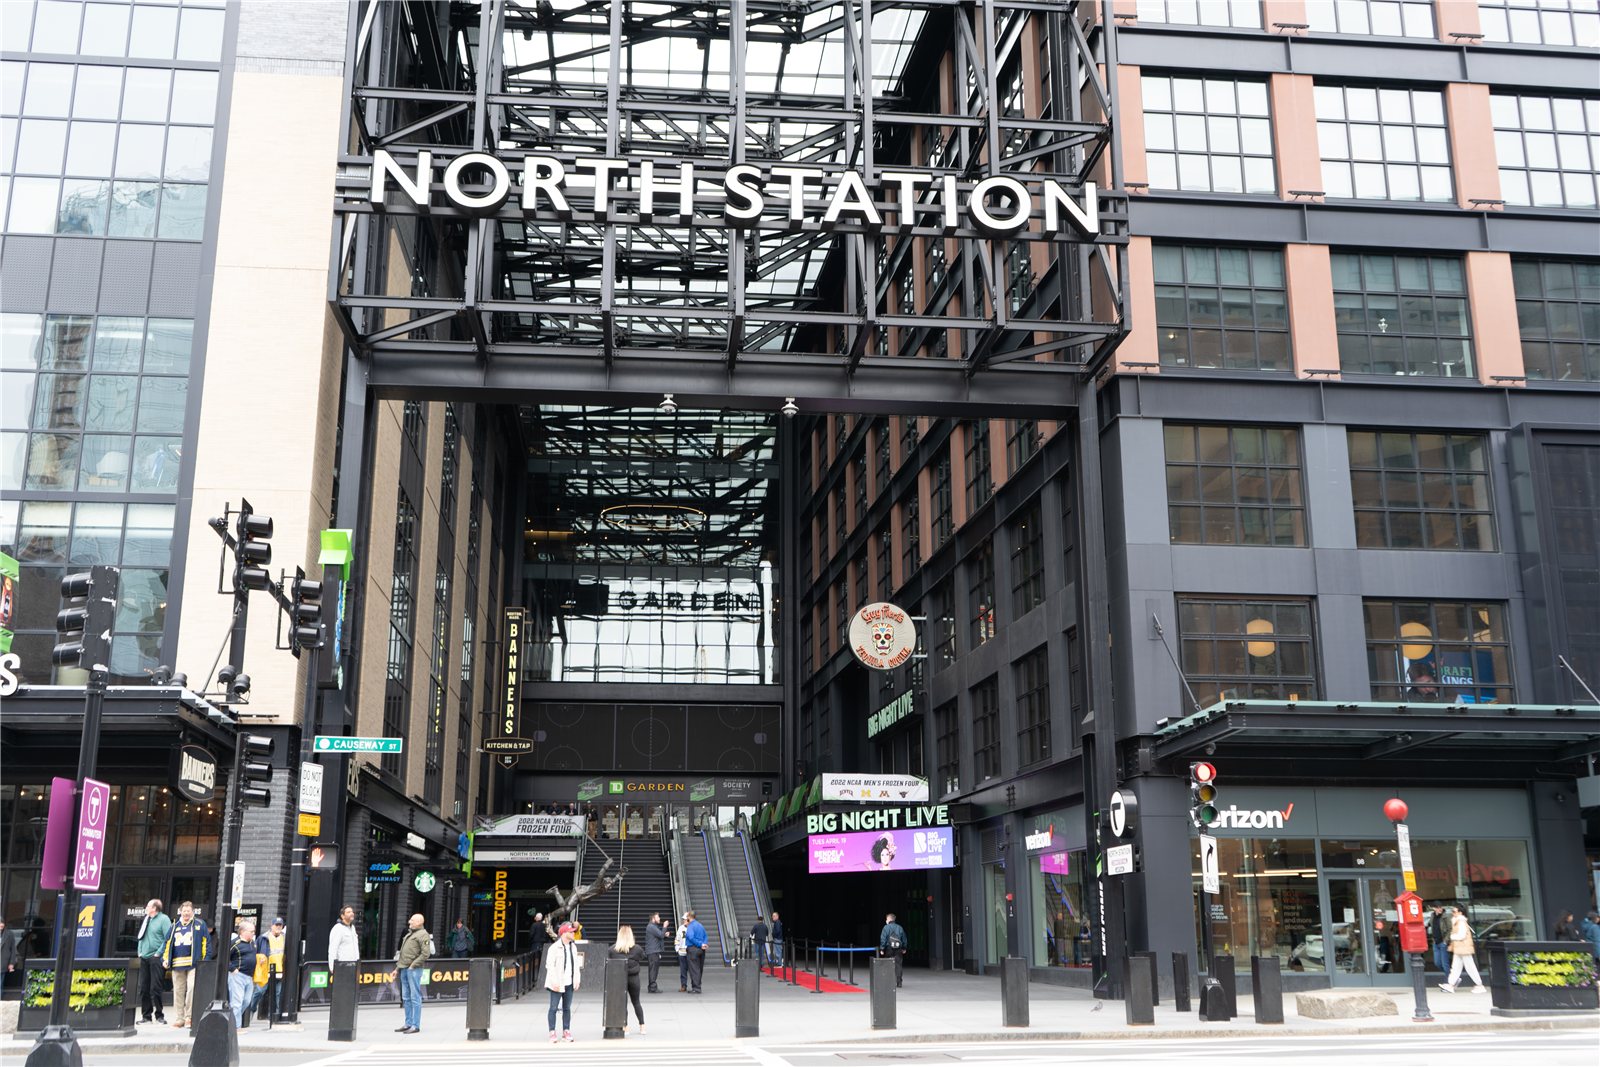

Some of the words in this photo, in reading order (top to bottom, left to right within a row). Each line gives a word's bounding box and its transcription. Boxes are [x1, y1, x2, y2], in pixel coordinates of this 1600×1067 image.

[371, 150, 694, 214] NORTH
[724, 163, 1101, 235] STATION
[505, 623, 518, 734] BANNERS
[1441, 666, 1472, 677] RAFT
[867, 713, 879, 739] BIG
[878, 700, 897, 732] NIGHT
[897, 689, 914, 720] LIVE
[334, 740, 384, 750] CAUSEWAY
[181, 751, 215, 789] BANNERS
[612, 783, 623, 791] TD
[627, 783, 684, 791] GARDEN
[807, 814, 838, 833] BIG
[841, 808, 901, 831] NIGHT
[905, 805, 949, 827] LIVE
[516, 825, 548, 833] FROZEN
[550, 825, 572, 833] FOUR
[174, 932, 192, 946] M
[432, 970, 469, 982] GARD
